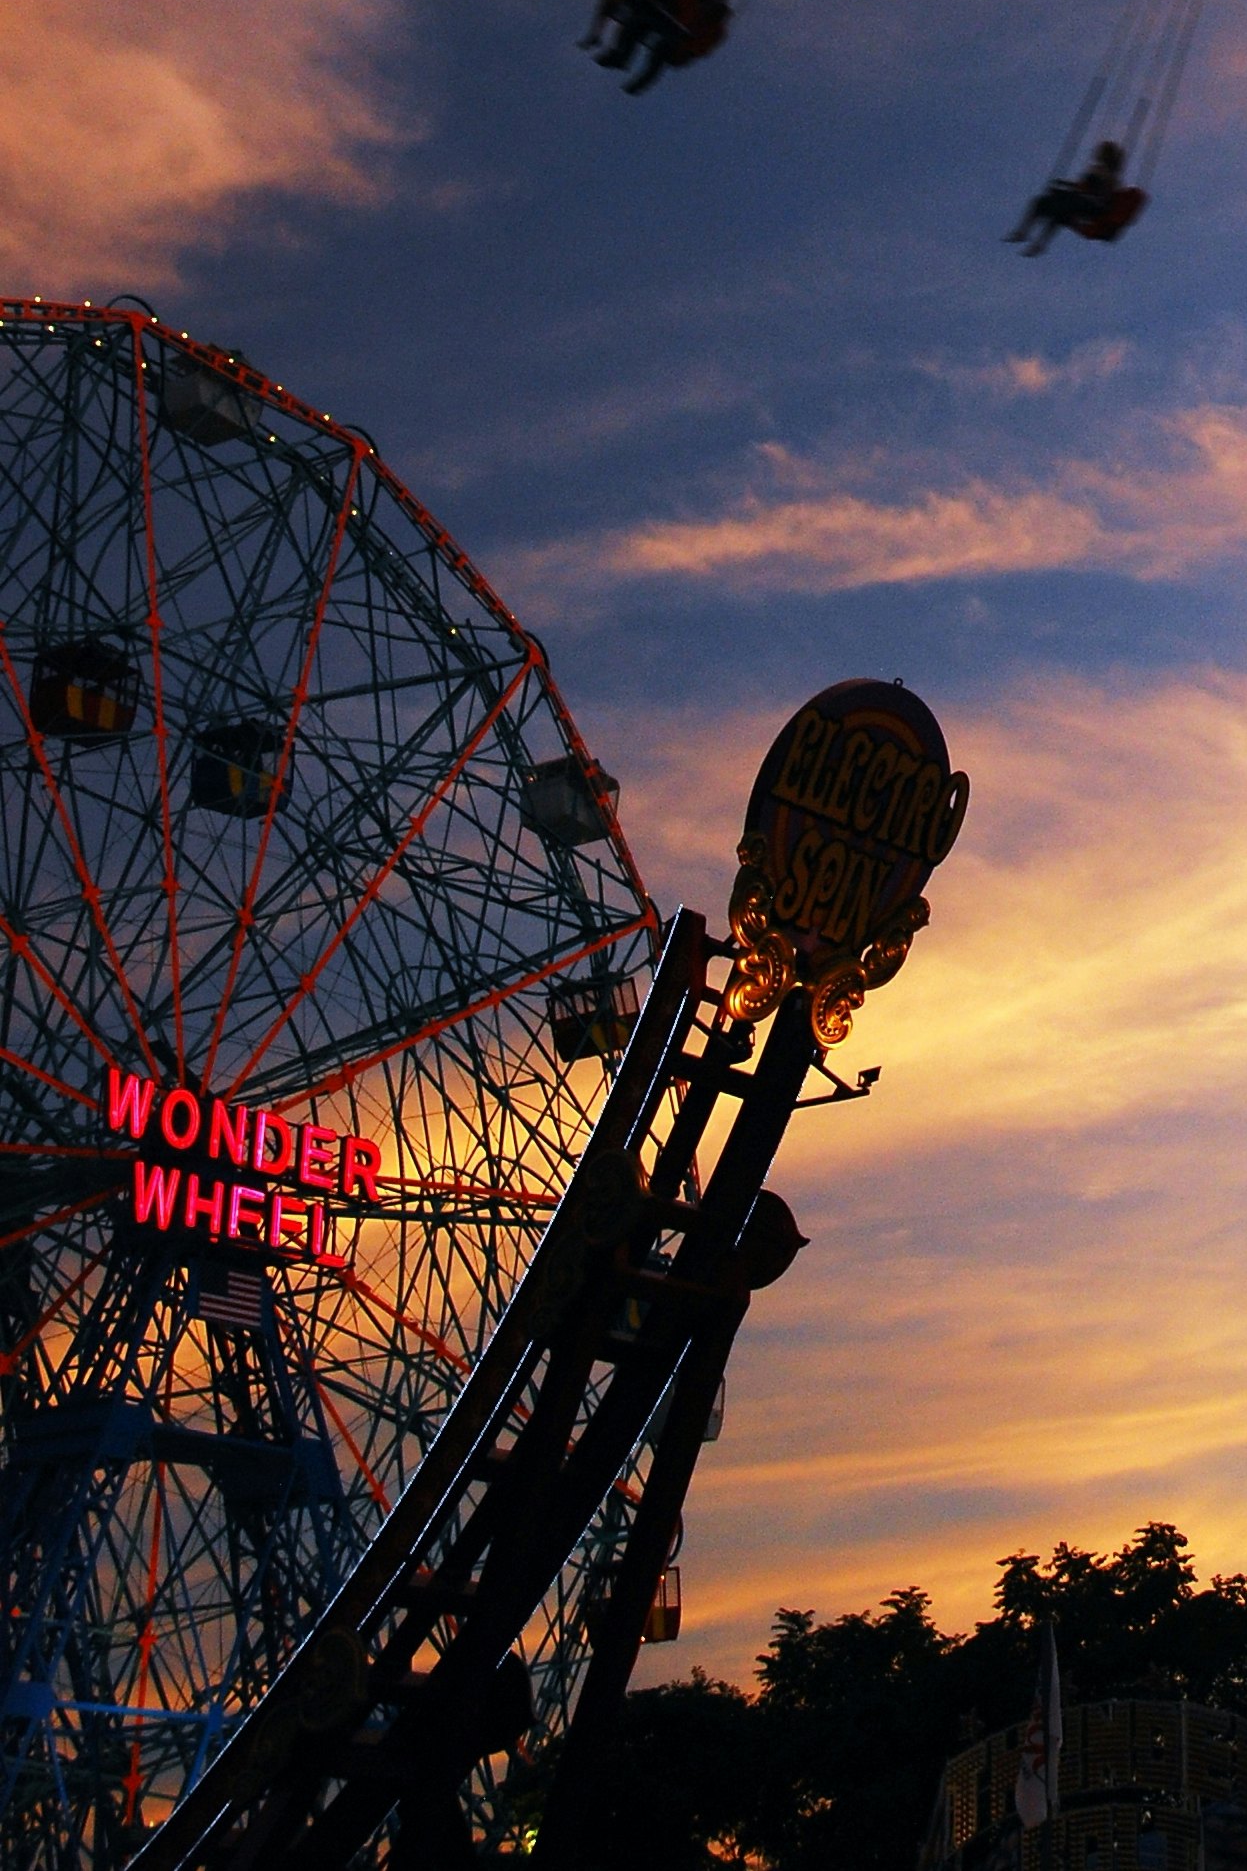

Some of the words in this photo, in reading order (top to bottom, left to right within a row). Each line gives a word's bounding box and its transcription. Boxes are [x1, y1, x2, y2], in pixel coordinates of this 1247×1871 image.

[771, 707, 970, 865] ELECTRO
[775, 824, 892, 954] SPIN
[106, 1067, 383, 1202] WONDER
[133, 1160, 347, 1268] WHEEL
